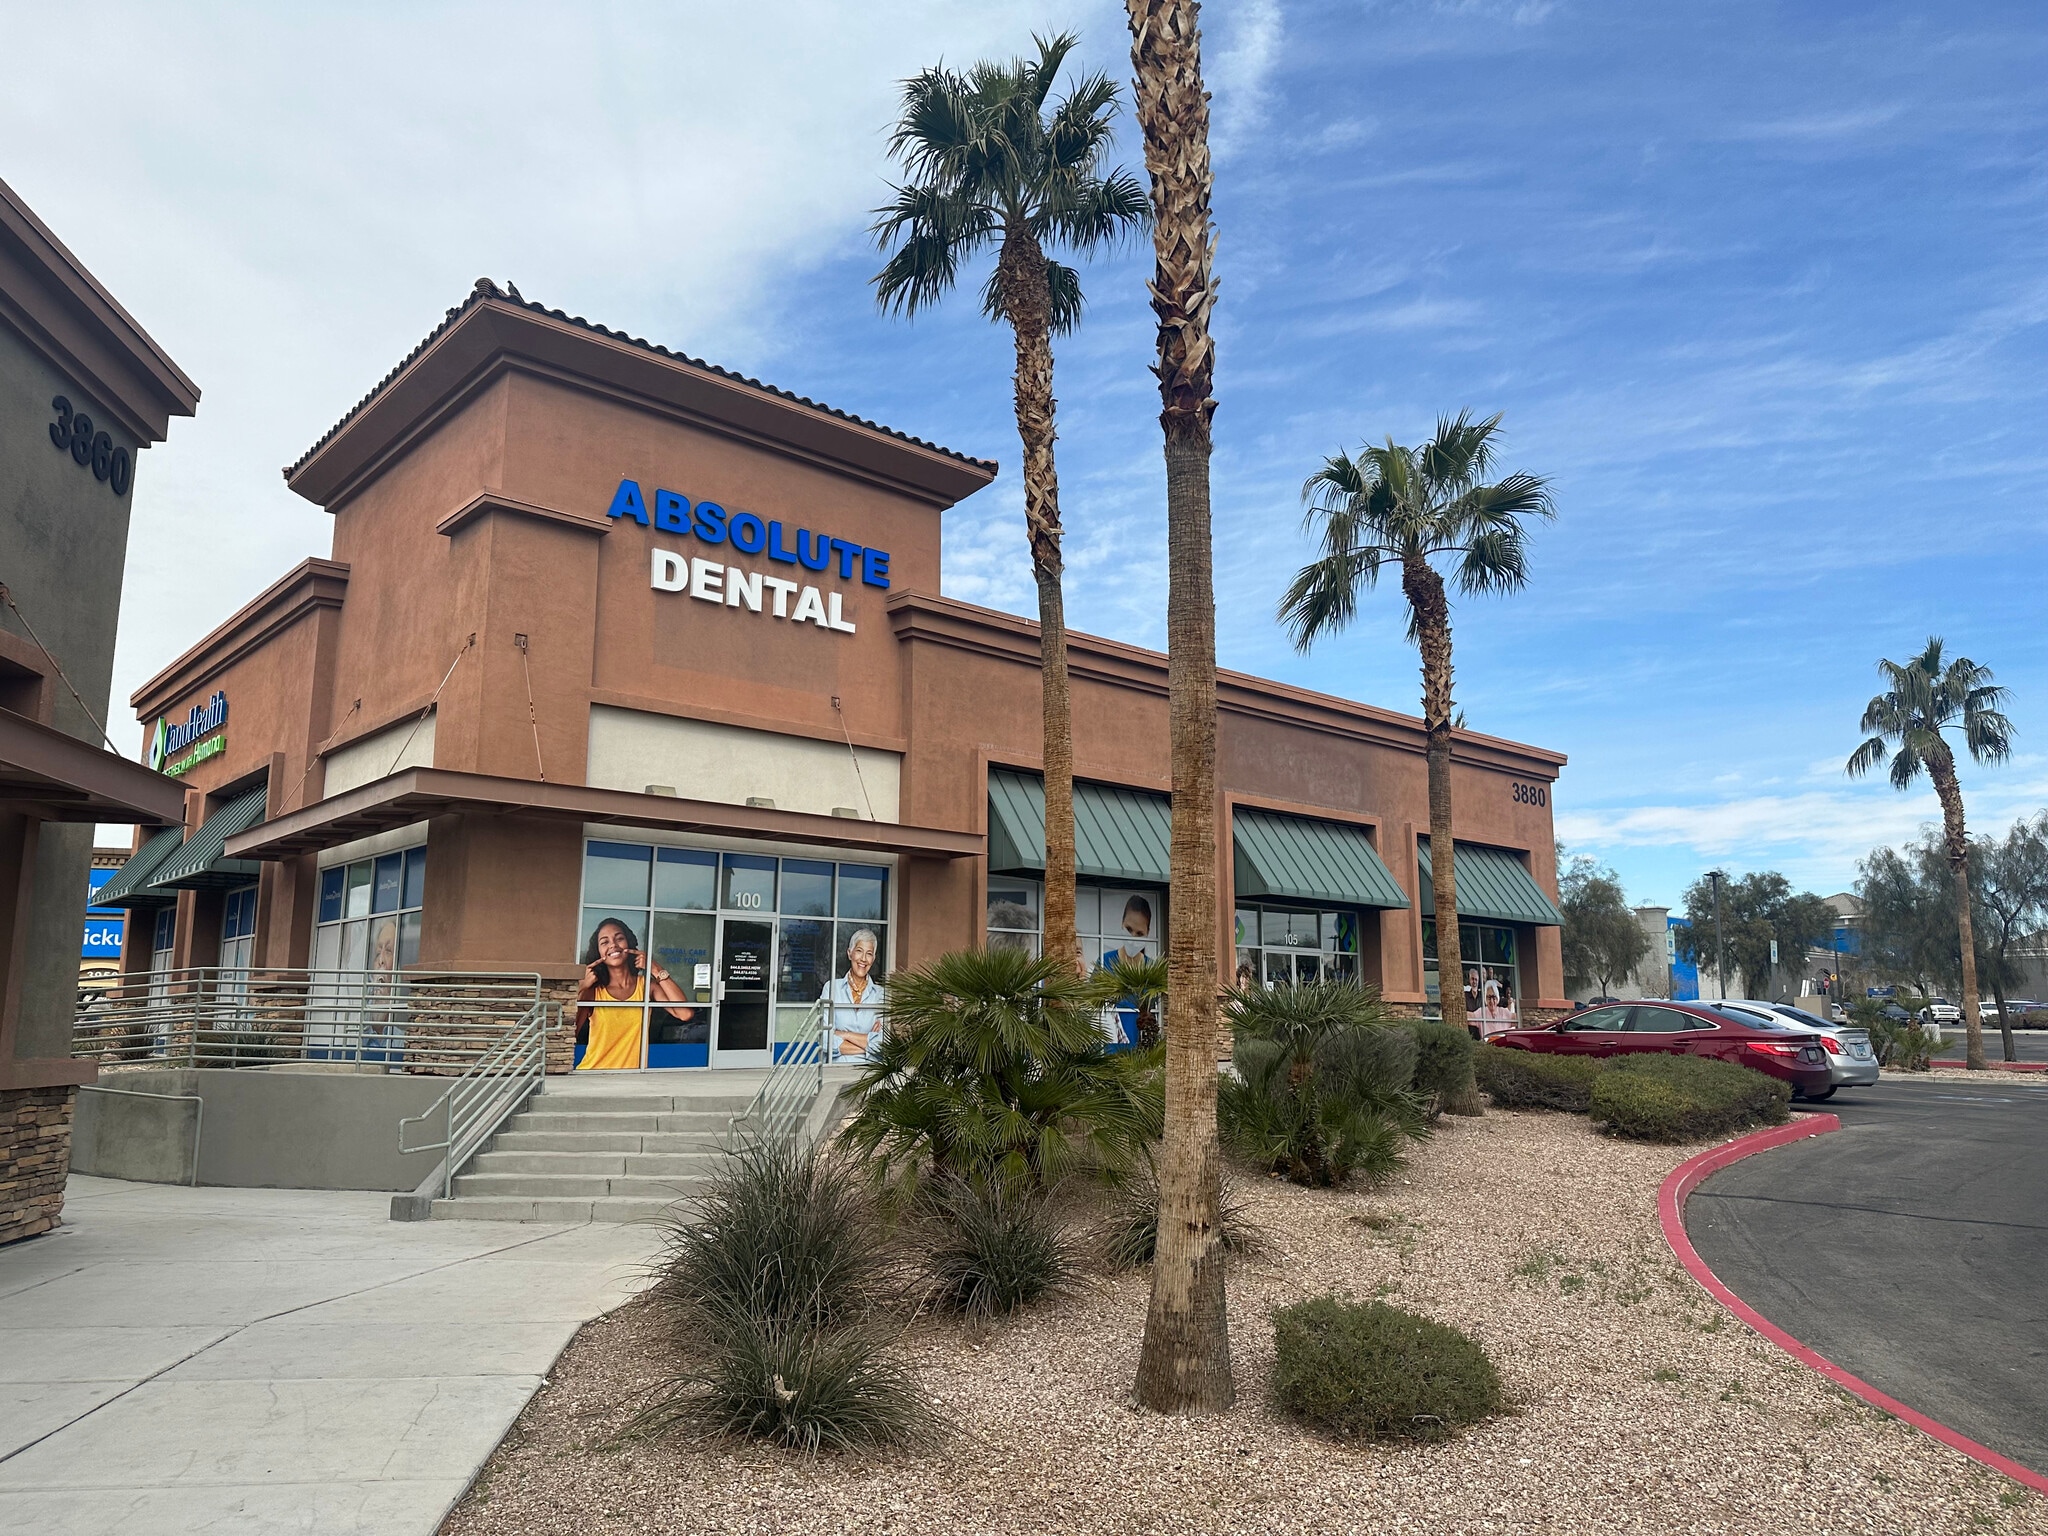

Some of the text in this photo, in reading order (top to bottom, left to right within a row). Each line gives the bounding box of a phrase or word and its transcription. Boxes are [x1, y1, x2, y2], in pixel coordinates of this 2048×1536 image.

[49, 395, 131, 496] 3860
[606, 479, 890, 589] ABSOLUTE
[650, 547, 856, 634] DENTAL
[1512, 782, 1546, 808] 3880
[735, 892, 761, 909] 100
[1284, 933, 1298, 945] 105
